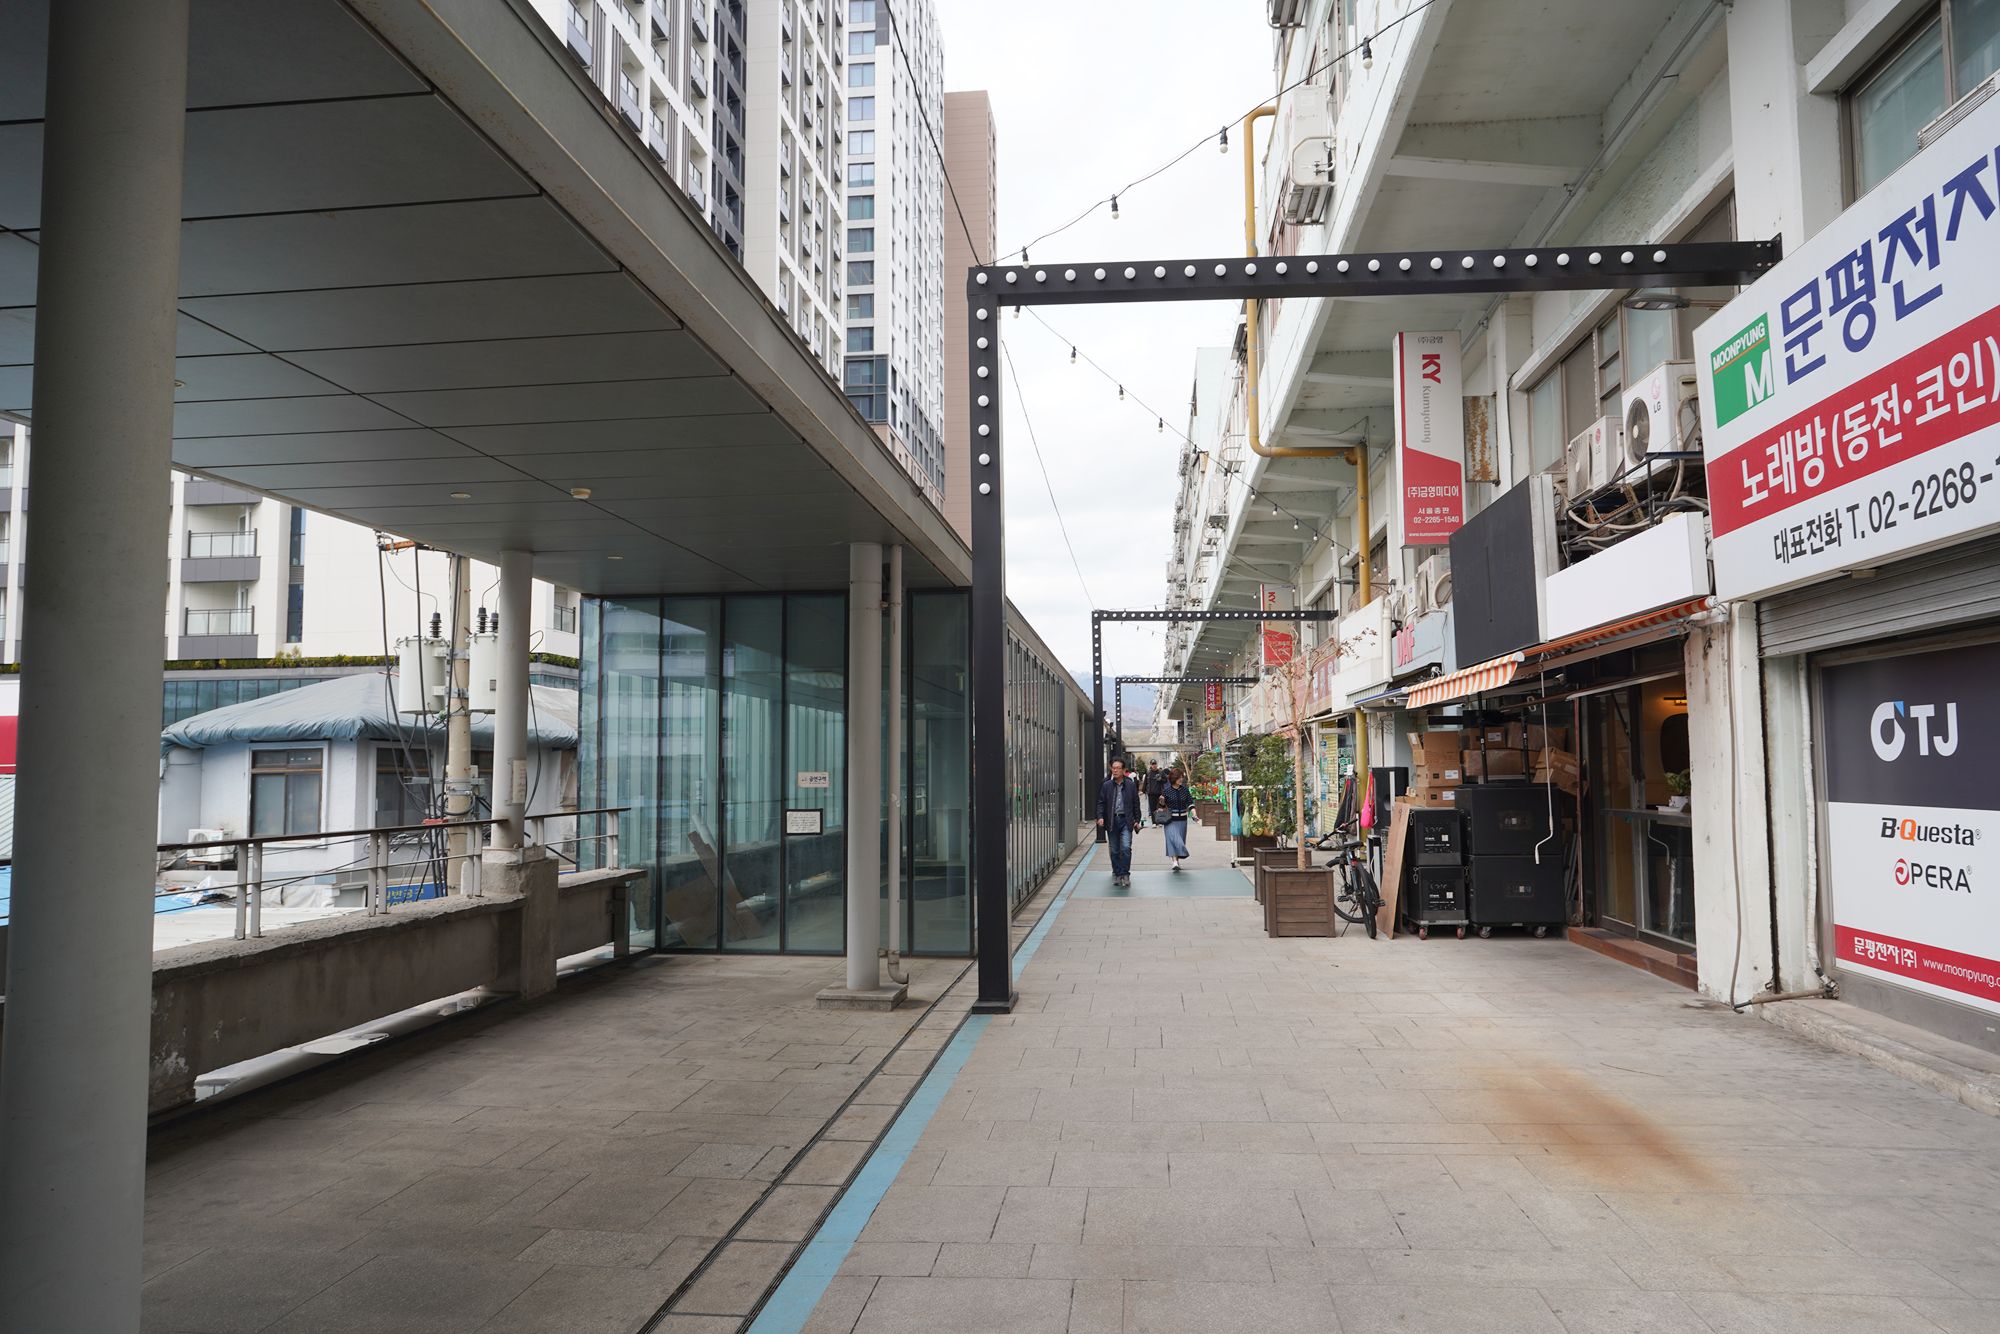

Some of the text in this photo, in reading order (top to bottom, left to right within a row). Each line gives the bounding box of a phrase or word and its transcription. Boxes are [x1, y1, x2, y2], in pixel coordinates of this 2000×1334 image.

[1713, 322, 1766, 371] MOONPYUNG
[1422, 353, 1441, 385] KY
[1744, 349, 1774, 409] M
[1421, 385, 1432, 444] Kumyoung
[1653, 401, 1662, 414] LG
[1407, 486, 1459, 498] (주)금영미디어
[1773, 508, 1842, 564] 대표전화
[1268, 591, 1276, 603] KY
[1894, 858, 1972, 893] OPERA
